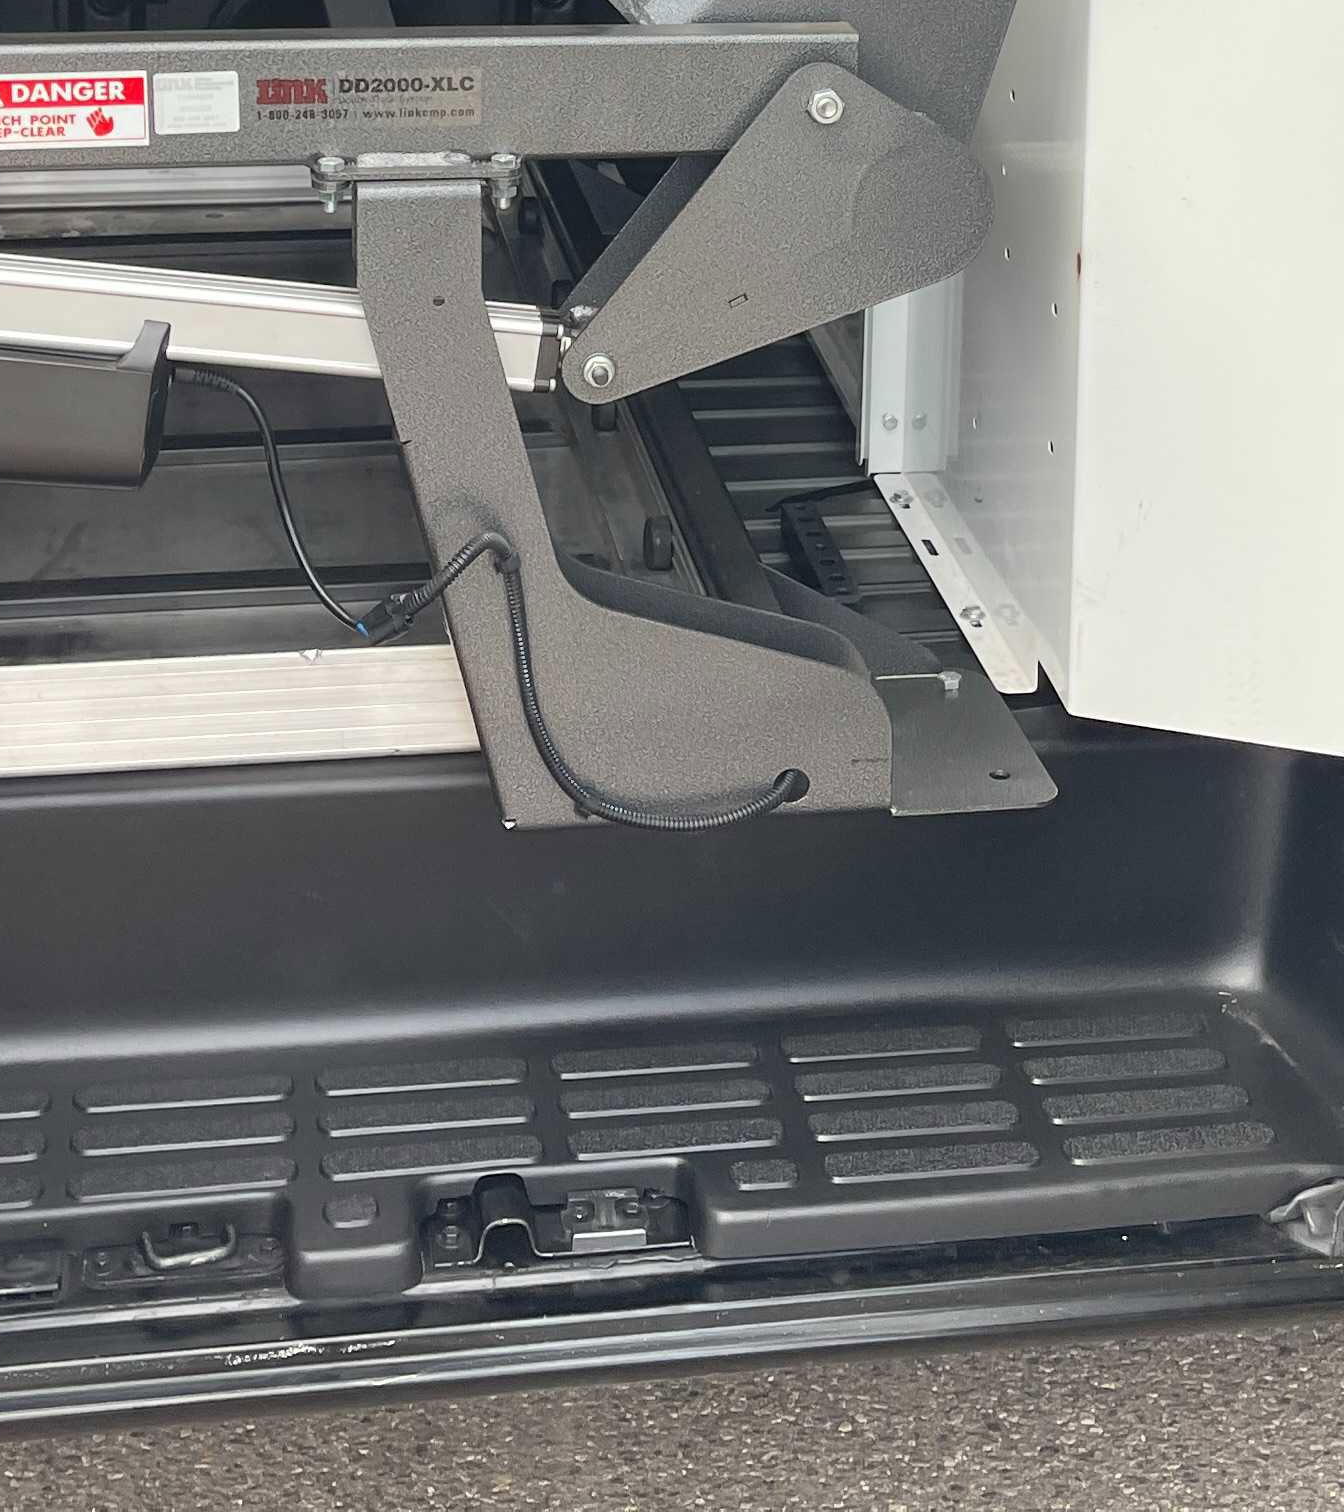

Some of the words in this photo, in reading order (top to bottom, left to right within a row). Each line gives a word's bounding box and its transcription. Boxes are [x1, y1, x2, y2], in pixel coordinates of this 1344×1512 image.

[11, 81, 126, 103] DANGER
[339, 76, 475, 94] DD2000-XLC
[30, 114, 77, 126] POINT
